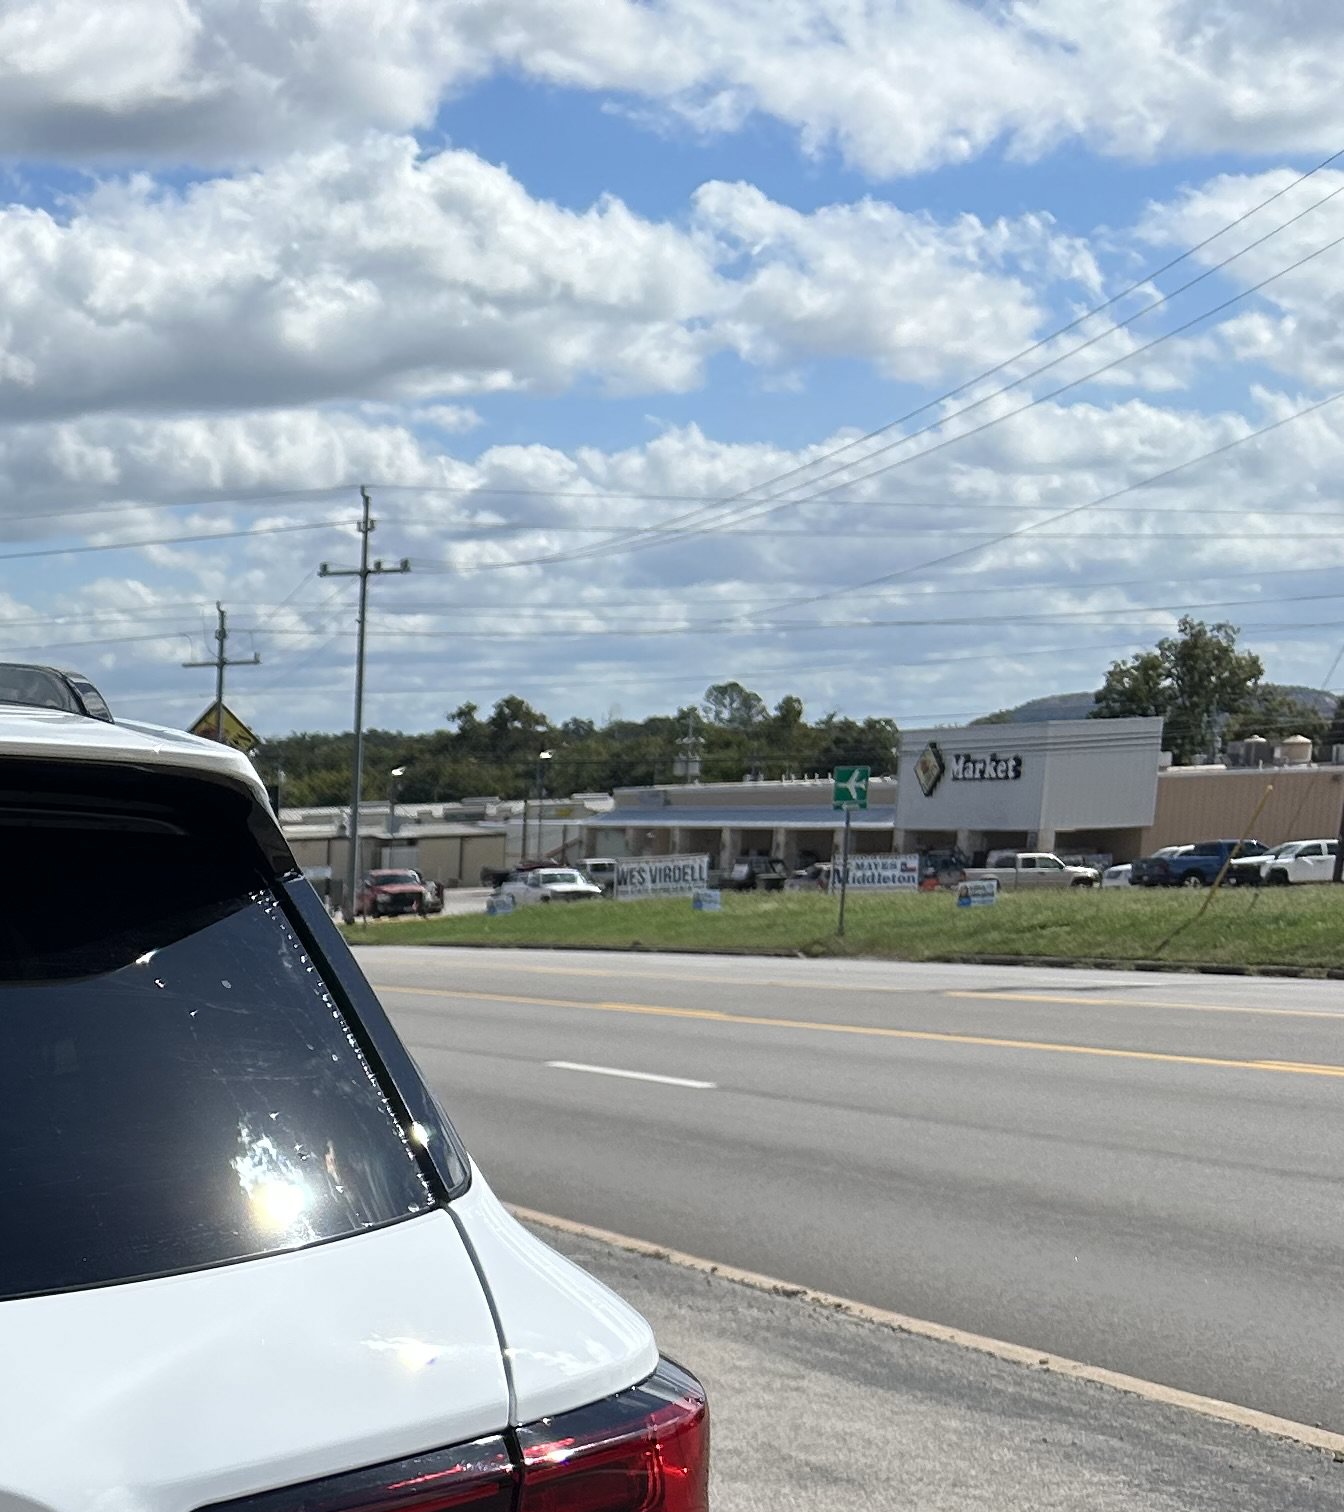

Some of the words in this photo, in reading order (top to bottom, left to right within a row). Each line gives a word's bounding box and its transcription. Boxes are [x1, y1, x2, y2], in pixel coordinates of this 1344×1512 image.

[951, 753, 1021, 781] Market
[616, 866, 646, 886] WES
[649, 863, 706, 884] VIRDELL
[832, 868, 916, 885] Middleton
